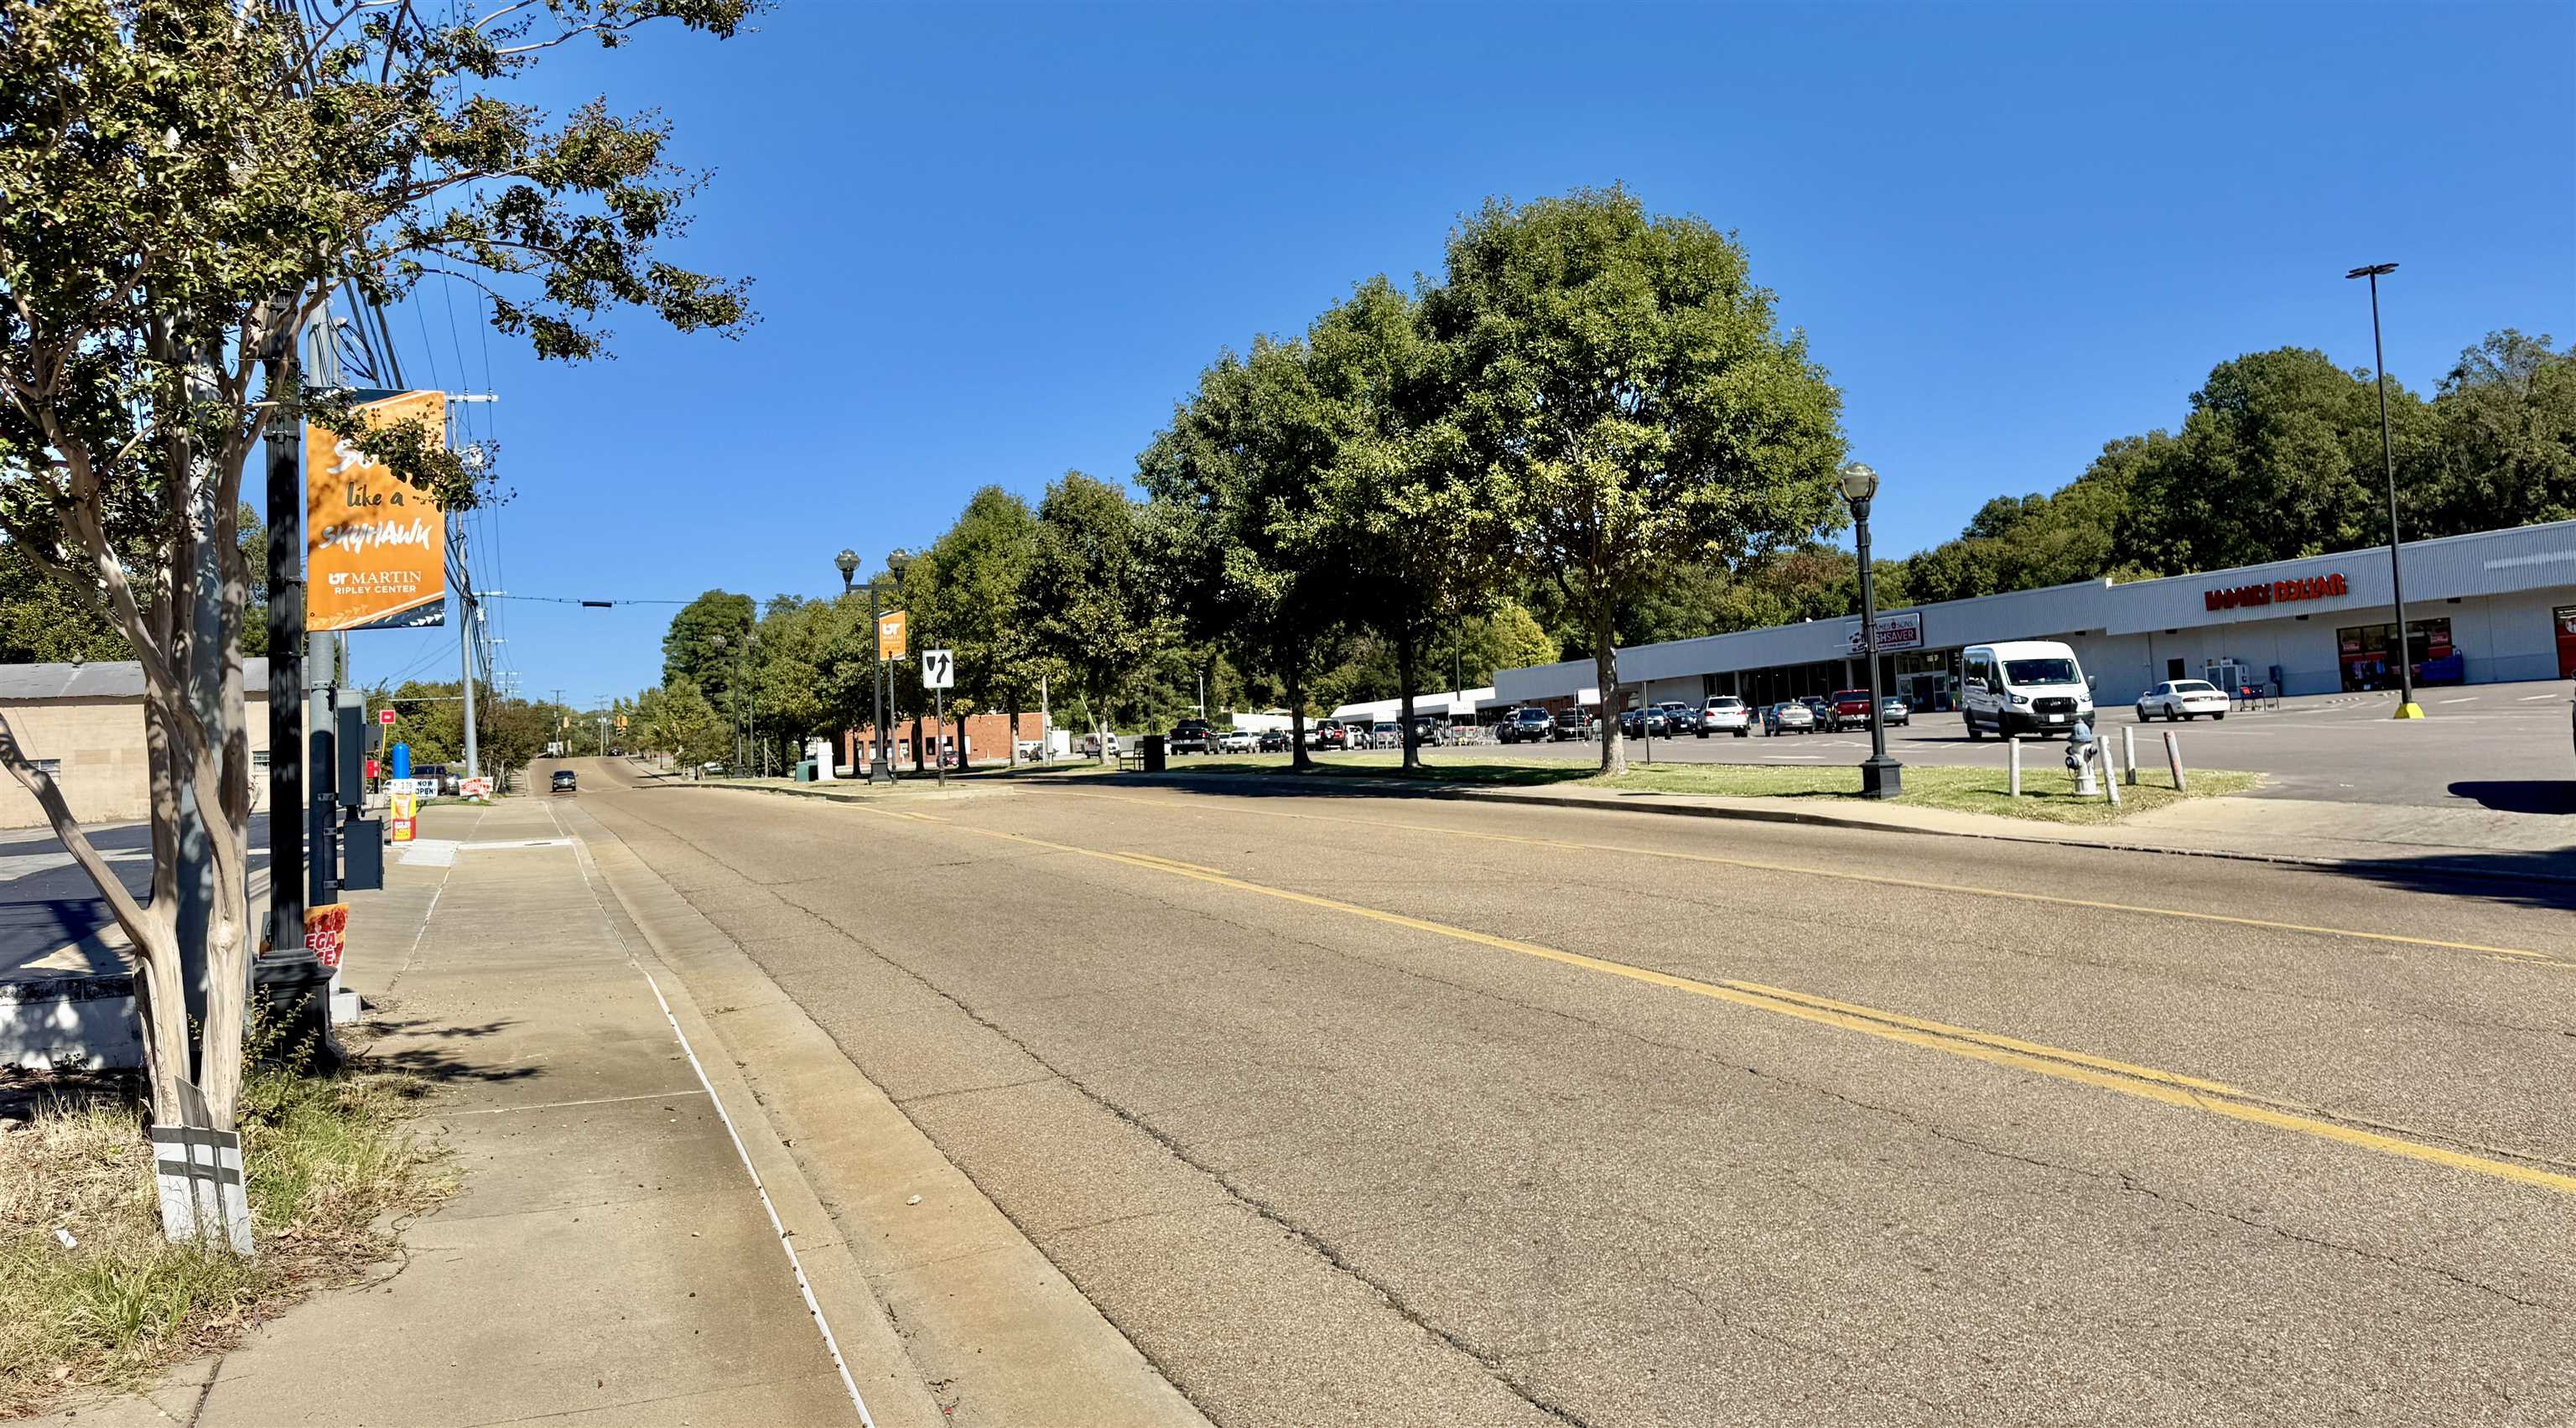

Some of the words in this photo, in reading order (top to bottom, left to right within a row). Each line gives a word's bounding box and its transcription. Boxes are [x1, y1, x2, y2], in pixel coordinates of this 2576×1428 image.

[347, 480, 382, 507] like
[390, 491, 404, 506] a
[328, 572, 350, 585] UT
[351, 570, 422, 584] MARTIN
[335, 585, 371, 595] RIPLEY
[375, 584, 417, 595] CENTER
[2205, 583, 2272, 611] FAMILY
[2273, 573, 2347, 604] DOLLAR
[304, 930, 336, 951] EGA
